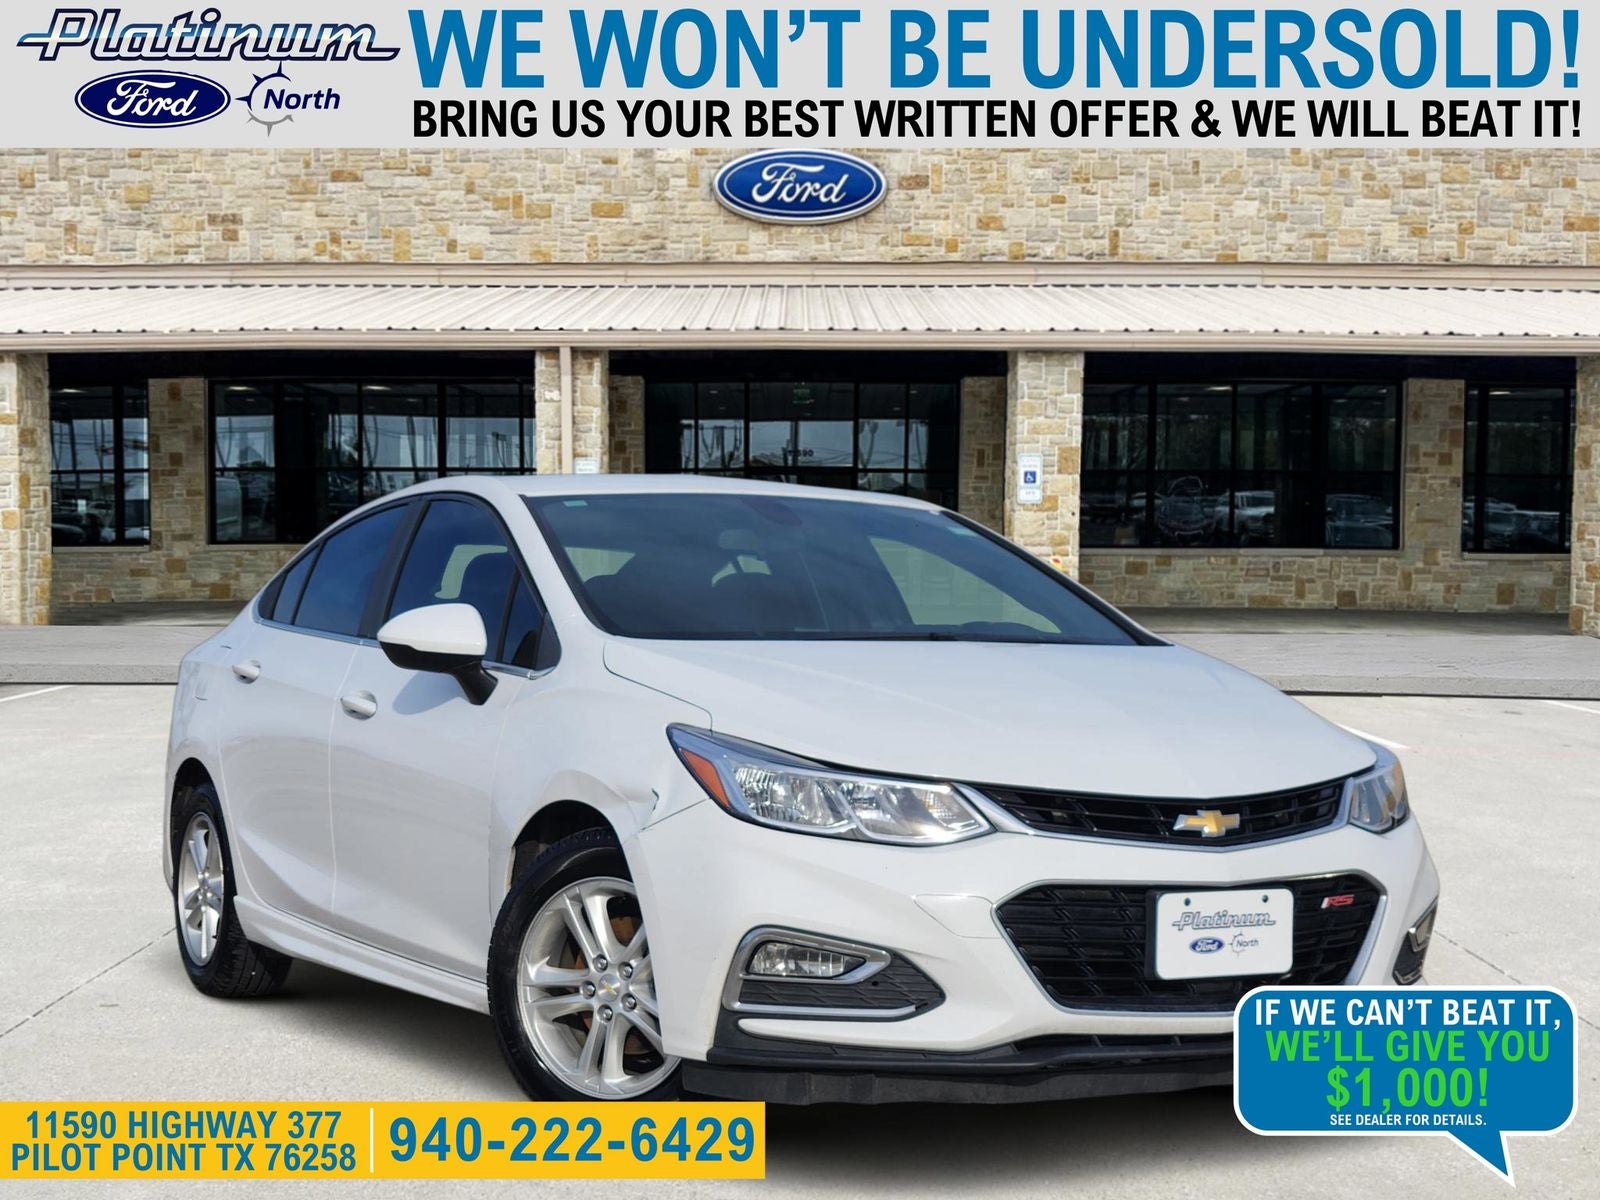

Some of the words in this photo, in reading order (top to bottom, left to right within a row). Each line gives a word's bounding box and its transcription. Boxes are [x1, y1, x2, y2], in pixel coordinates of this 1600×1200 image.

[751, 162, 849, 203] Ford
[1322, 894, 1354, 908] RS
[1172, 909, 1277, 931] Platinum
[1195, 939, 1219, 952] Ford
[1236, 938, 1259, 948] North
